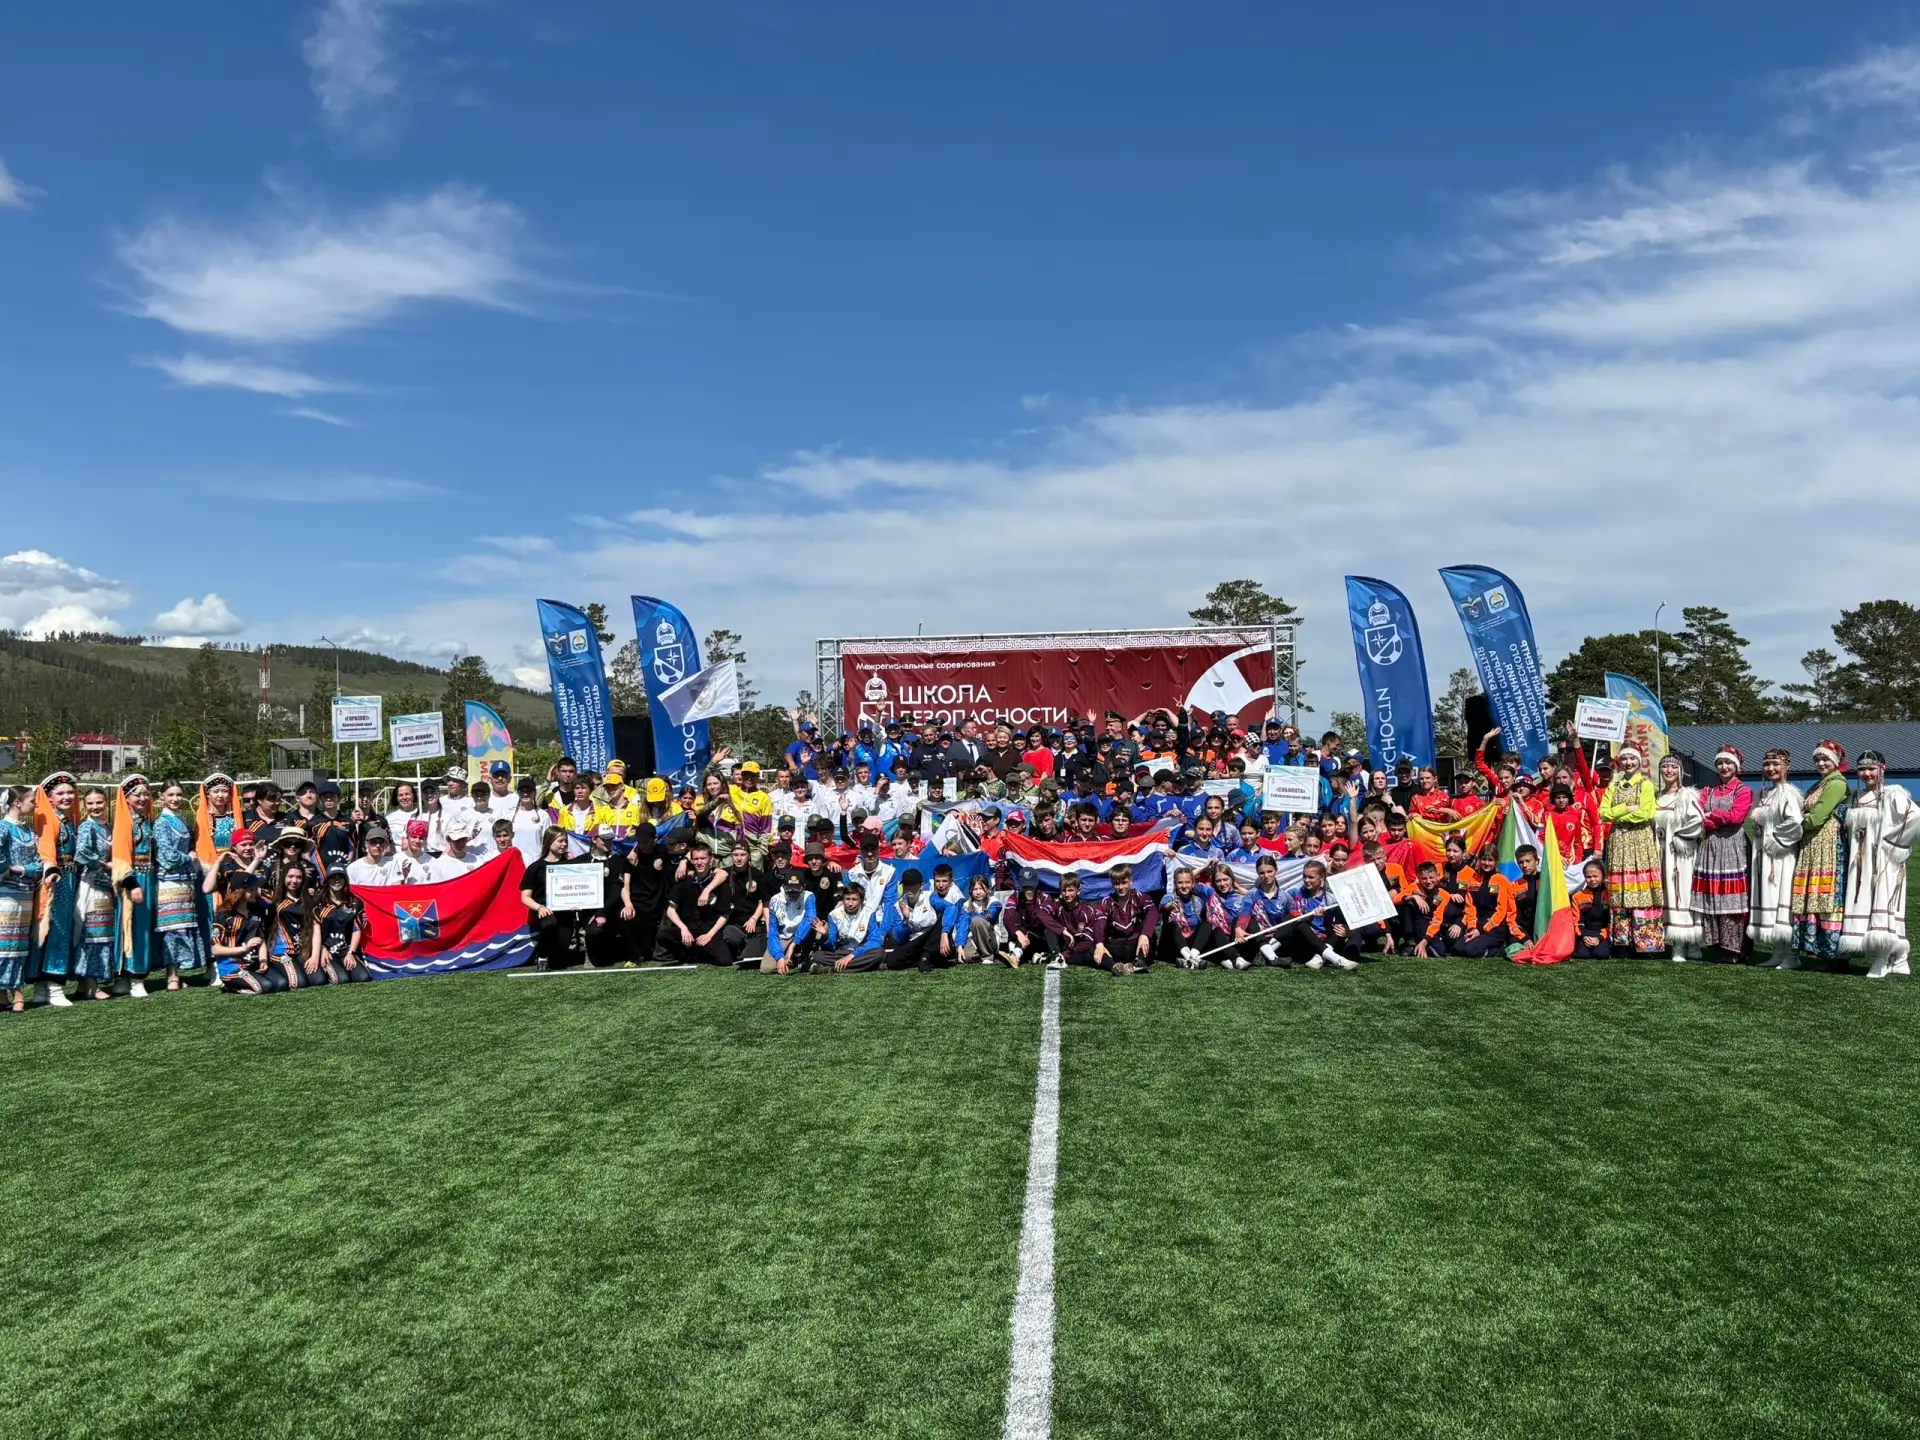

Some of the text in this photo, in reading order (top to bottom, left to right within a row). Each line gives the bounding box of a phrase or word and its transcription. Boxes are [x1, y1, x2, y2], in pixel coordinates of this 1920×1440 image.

[856, 661, 996, 672] Межрегиональные соревнования
[899, 684, 993, 705] ШКОЛА
